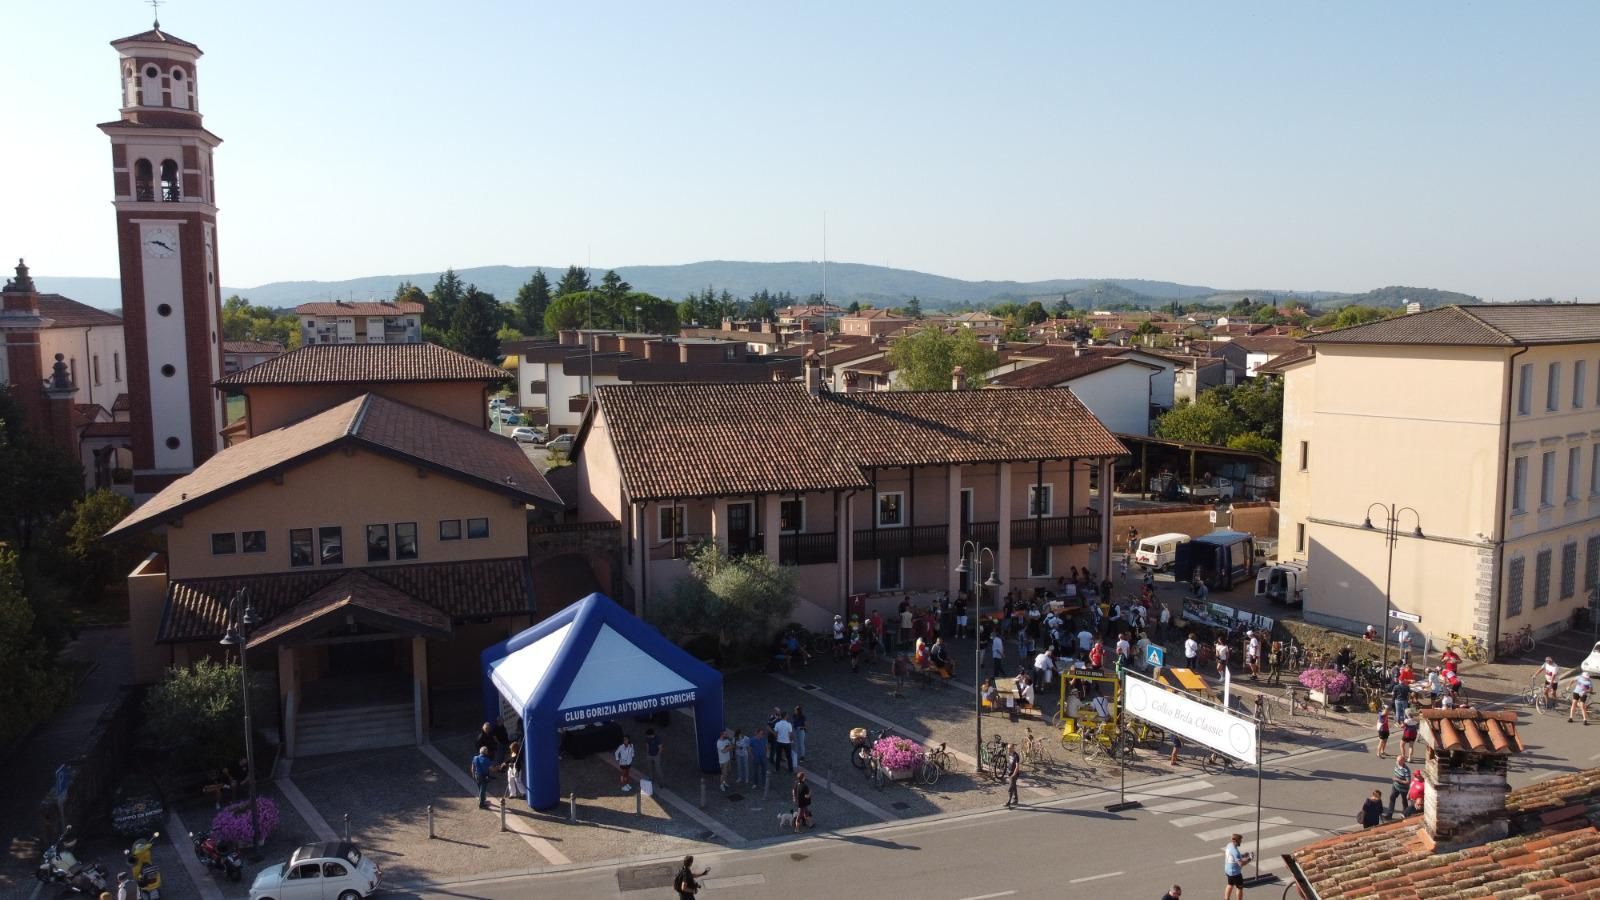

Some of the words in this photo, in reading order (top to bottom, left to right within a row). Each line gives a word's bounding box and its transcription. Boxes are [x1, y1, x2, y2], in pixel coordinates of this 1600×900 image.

[565, 710, 585, 722] CLUB
[586, 706, 617, 719] GORIZIA
[618, 699, 658, 714] AUTOMOTO
[660, 692, 696, 706] STORICHE
[1151, 699, 1173, 716] Collio
[1174, 708, 1193, 725] Brda
[1195, 717, 1224, 737] Classic
